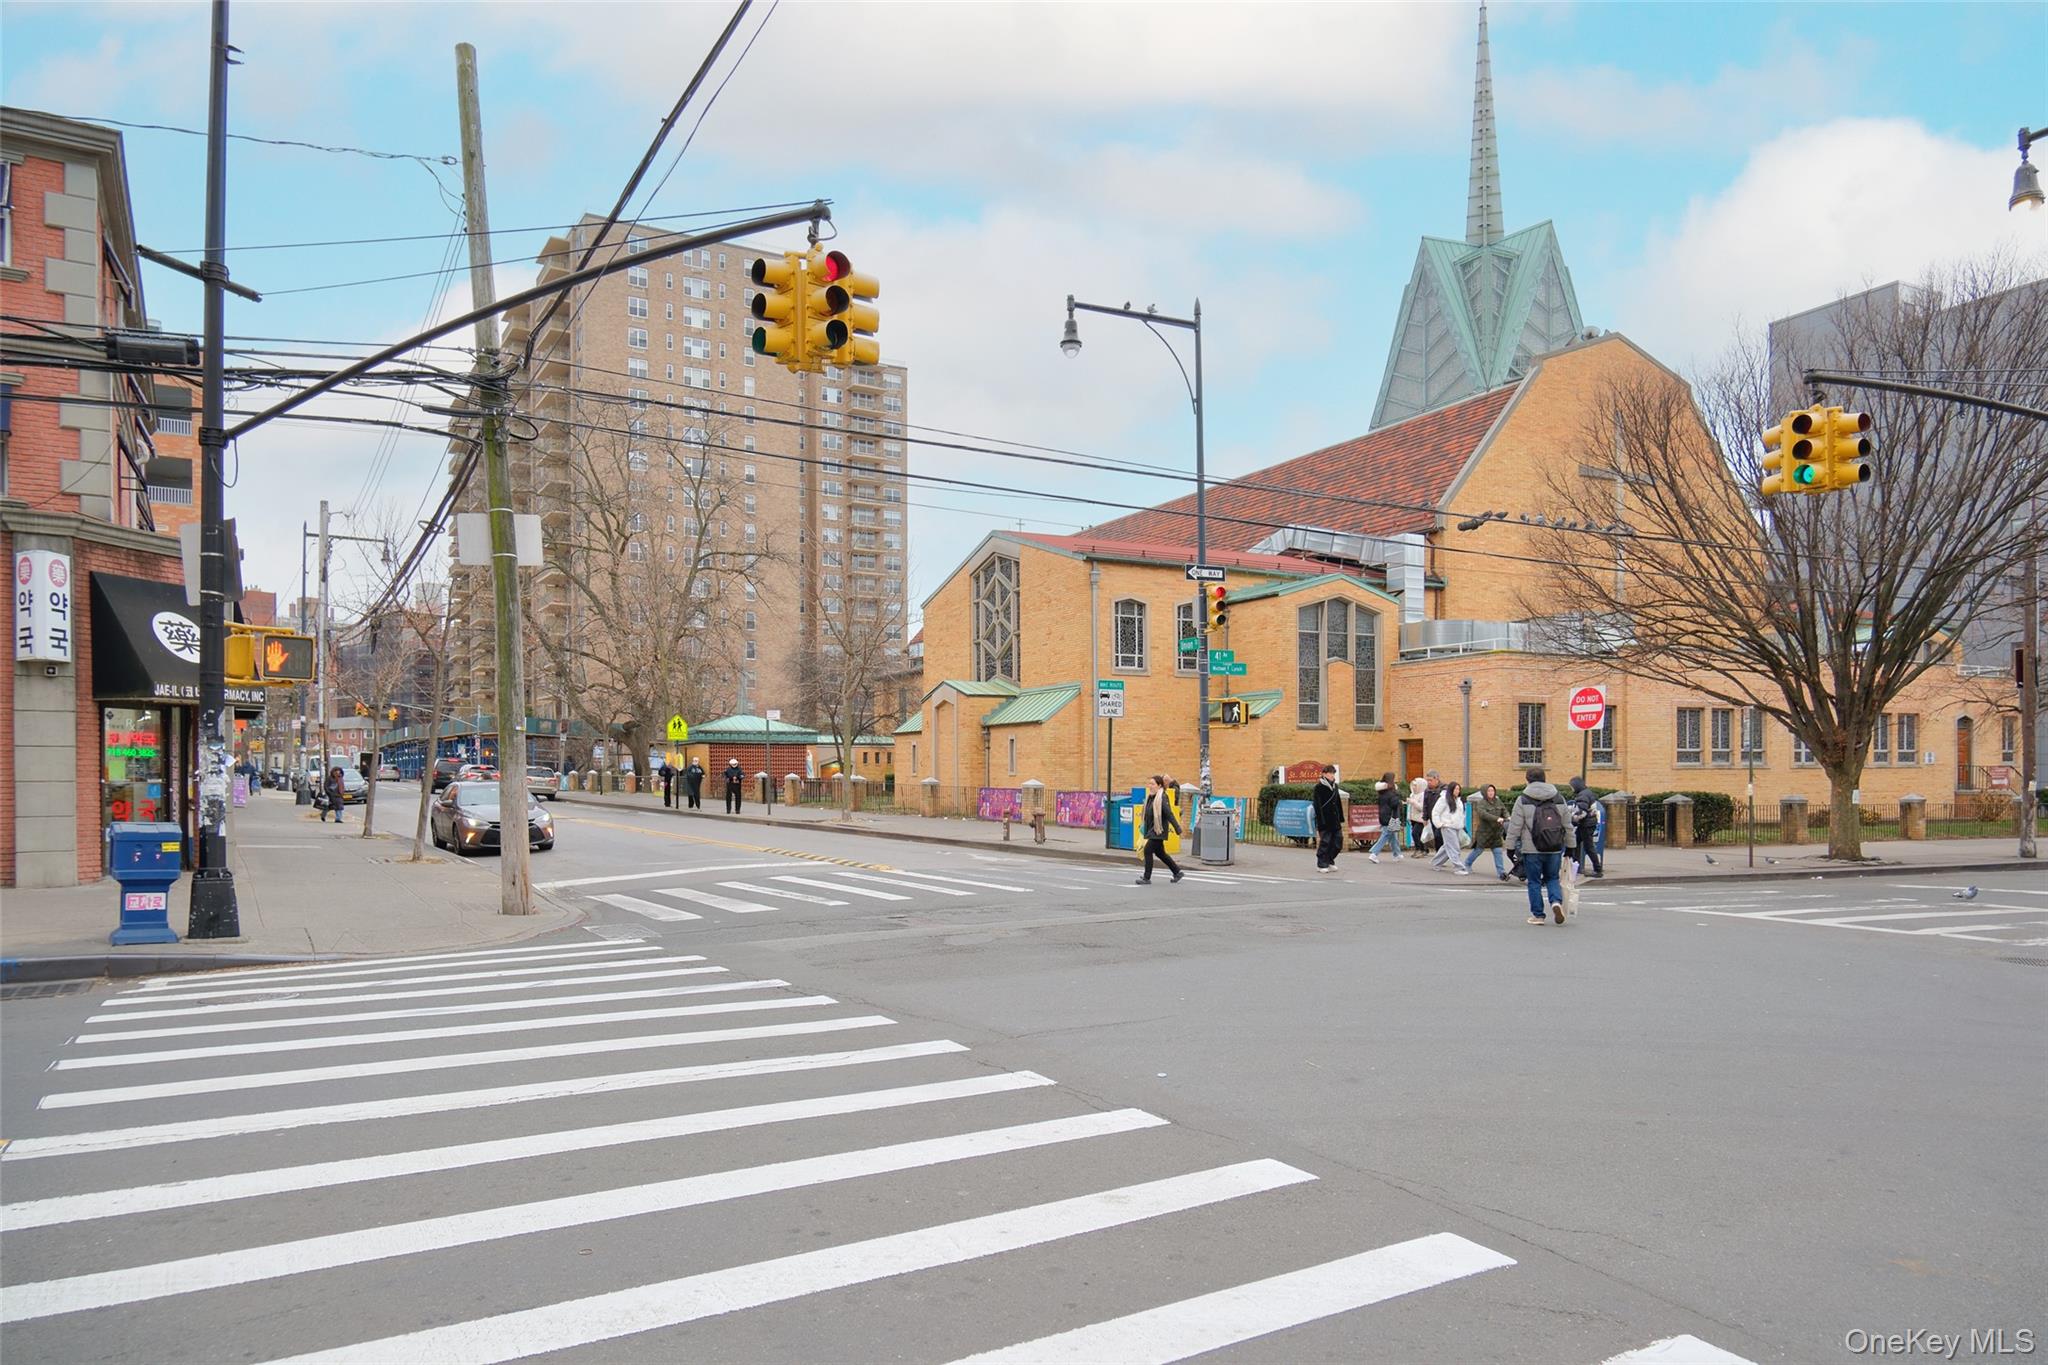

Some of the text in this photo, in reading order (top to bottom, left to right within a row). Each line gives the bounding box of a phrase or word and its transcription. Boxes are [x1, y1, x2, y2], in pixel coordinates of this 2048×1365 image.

[154, 683, 180, 697] JAE-IL
[251, 691, 265, 702] INC
[1576, 694, 1600, 704] DO NOT
[1577, 713, 1597, 721] ENTER
